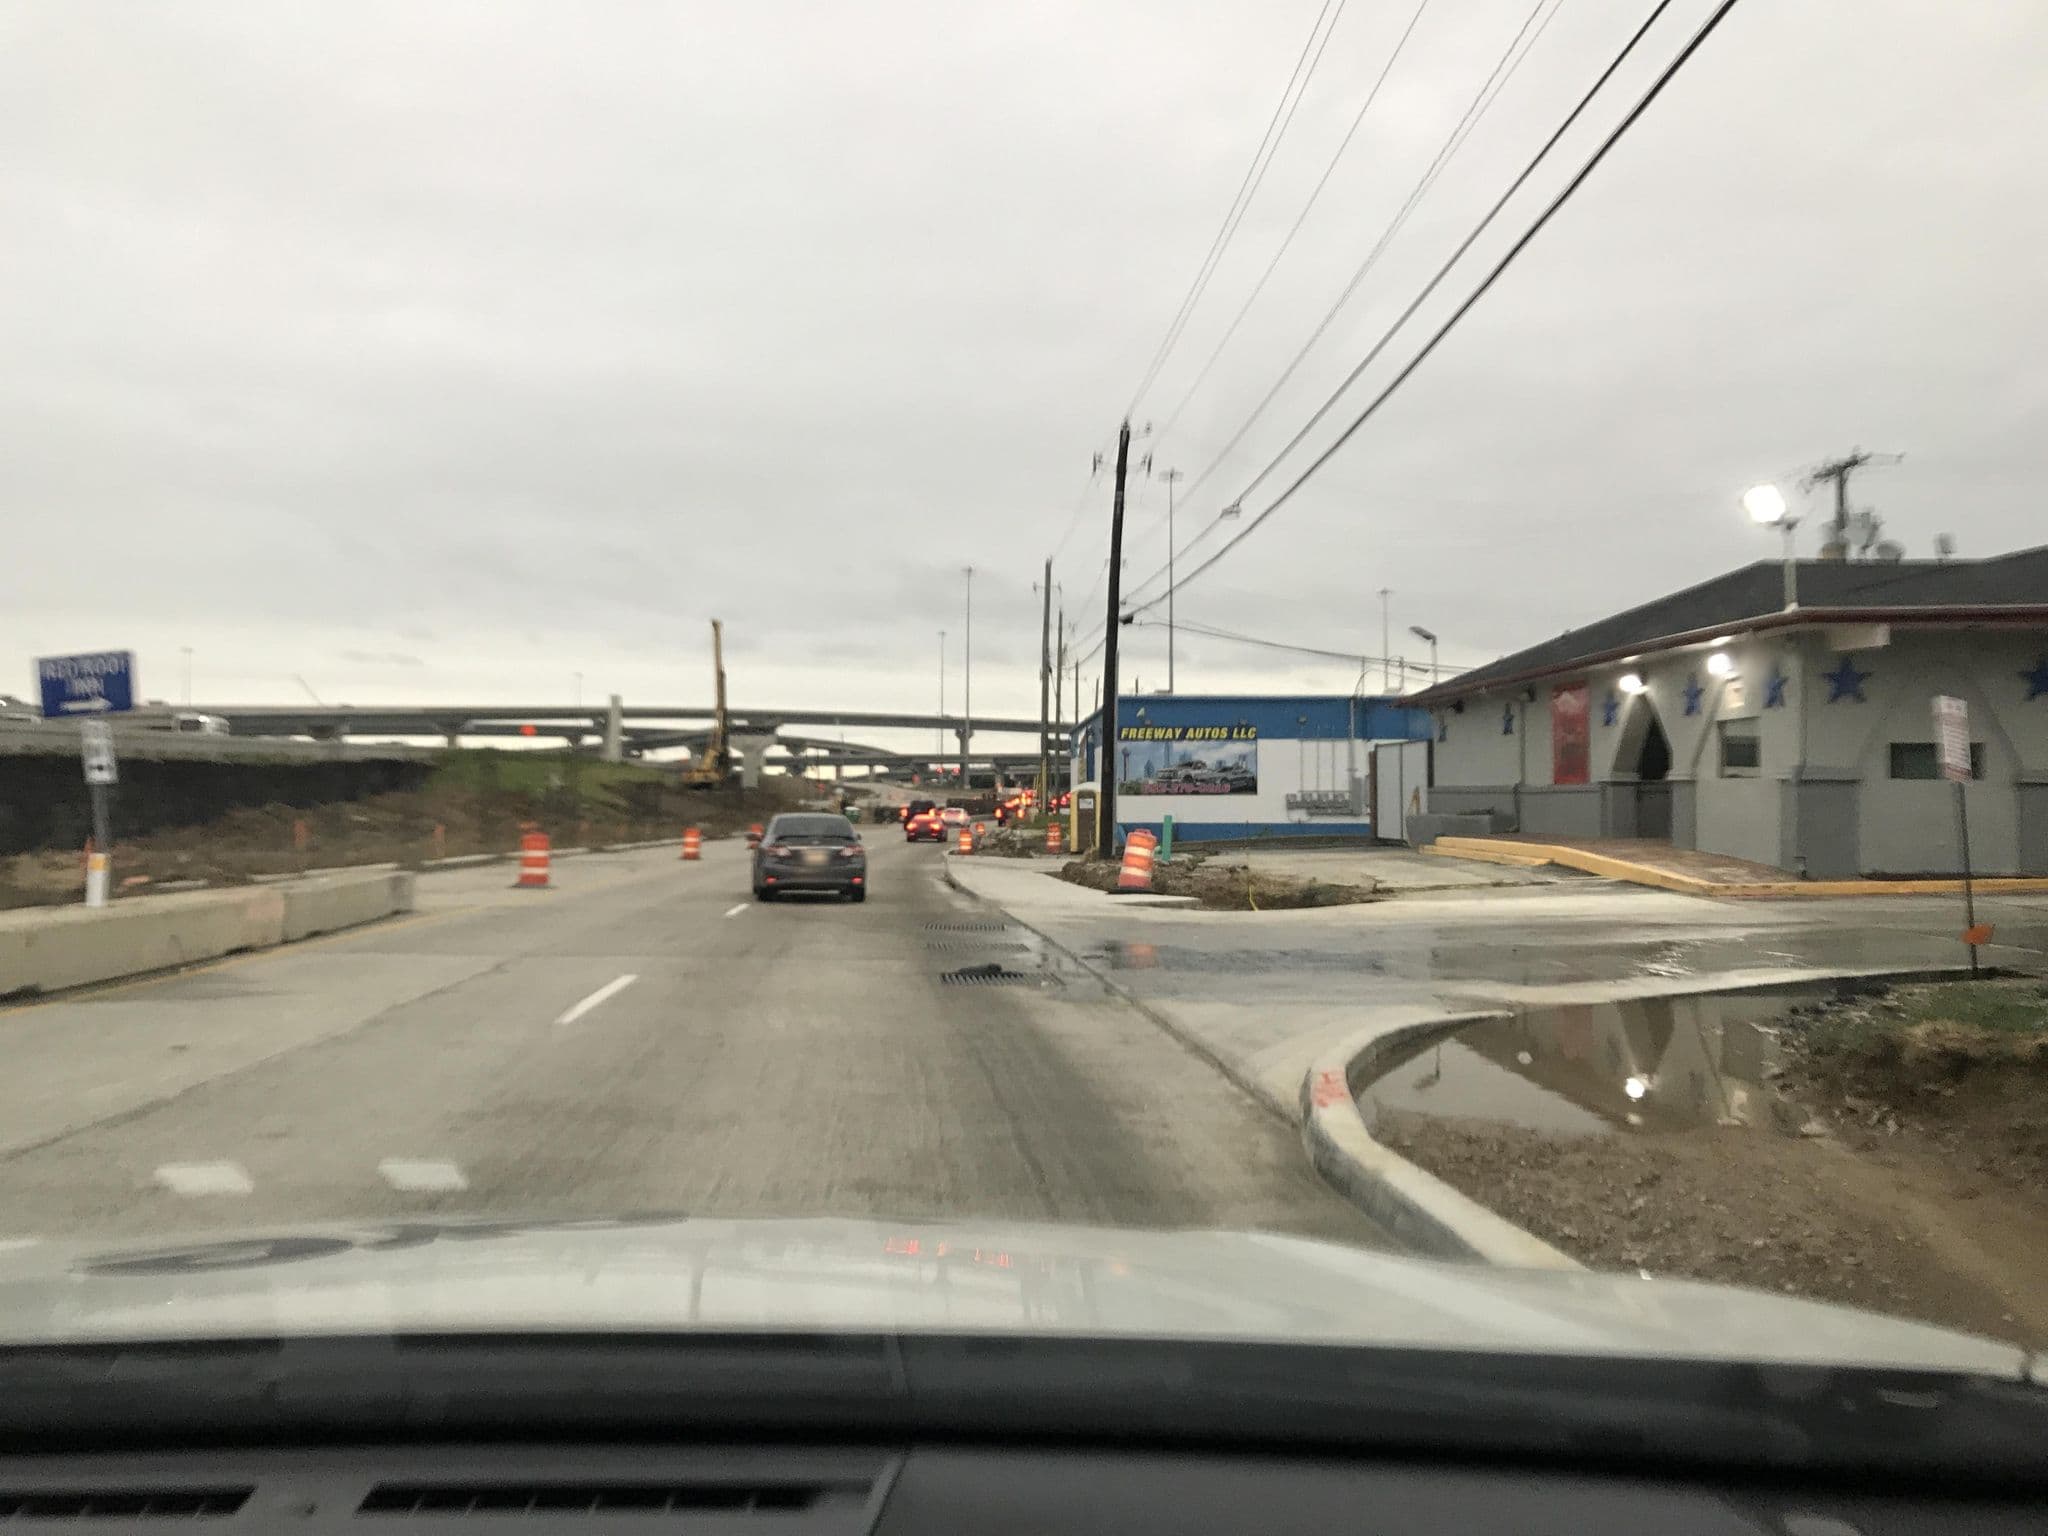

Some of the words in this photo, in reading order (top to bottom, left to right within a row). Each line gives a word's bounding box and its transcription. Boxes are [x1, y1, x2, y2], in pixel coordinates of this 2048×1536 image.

[1120, 727, 1183, 740] FREEWAY
[1185, 727, 1228, 739] AUTOS
[1232, 726, 1257, 739] LLC
